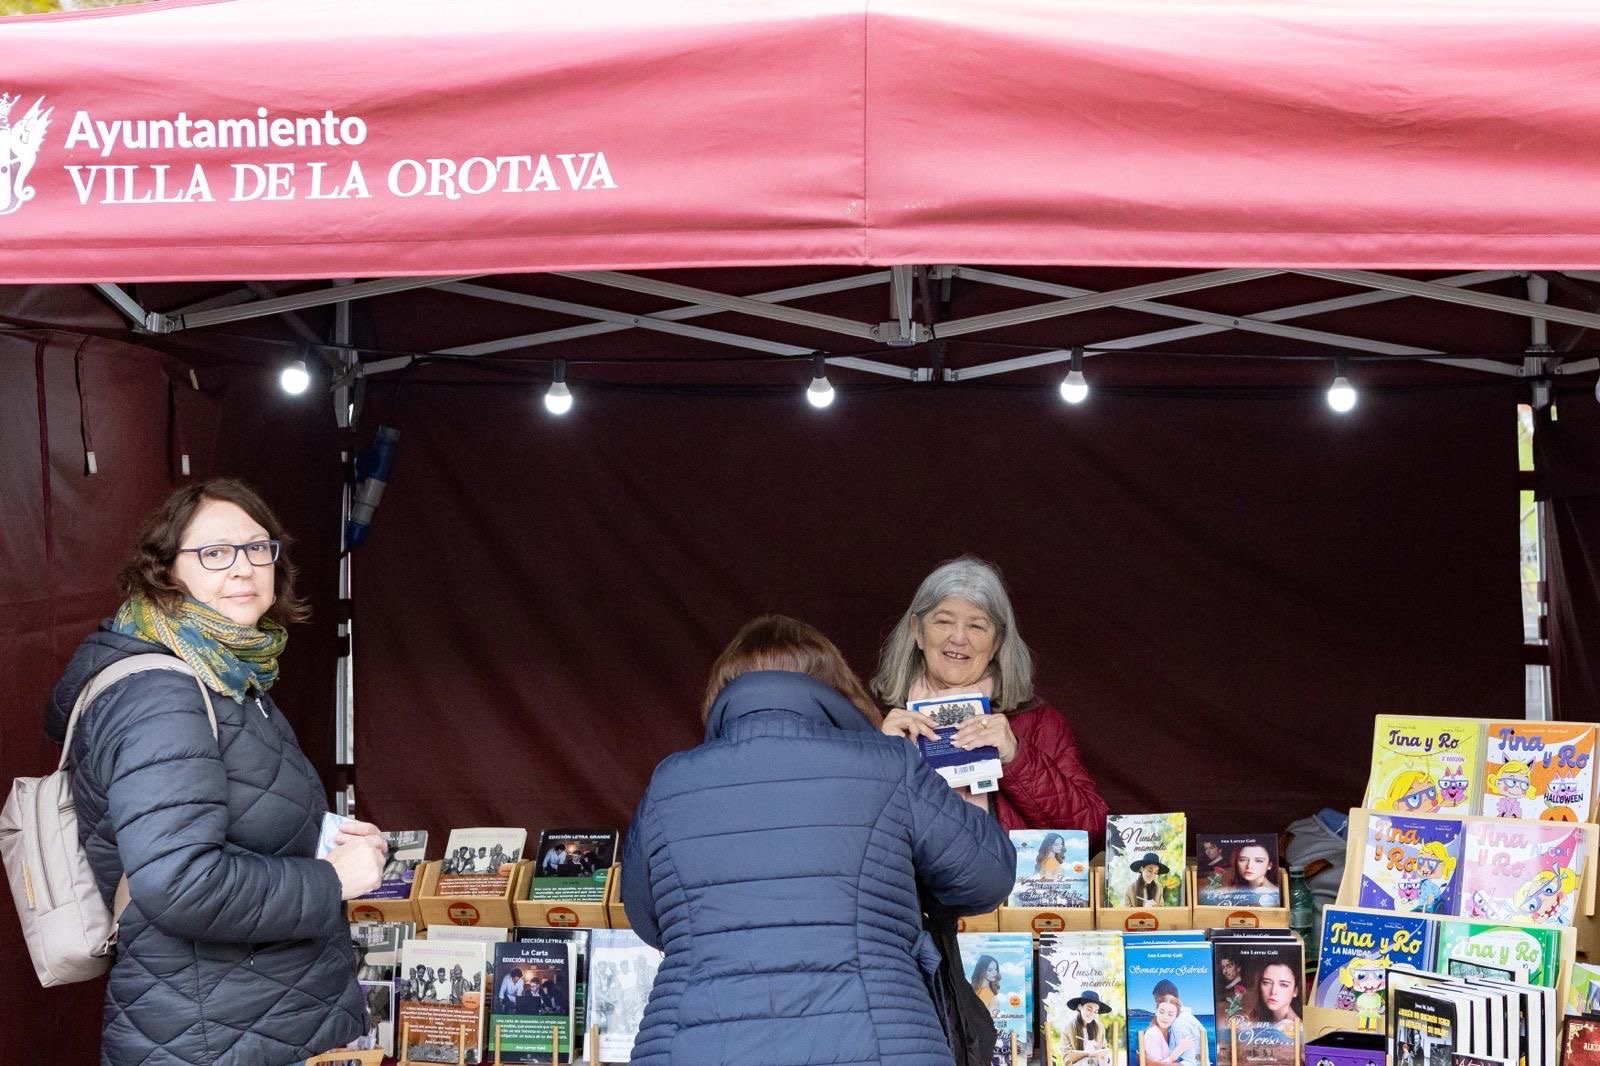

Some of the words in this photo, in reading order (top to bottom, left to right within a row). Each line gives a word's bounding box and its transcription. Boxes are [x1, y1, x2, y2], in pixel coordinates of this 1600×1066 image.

[64, 107, 368, 156] Ayuntamiento
[65, 163, 216, 205] VILLA
[230, 162, 296, 202] DE
[304, 160, 373, 201] LA
[386, 151, 619, 200] OROTAVA
[1388, 729, 1422, 747] Tina
[1424, 737, 1433, 752] y
[1438, 732, 1460, 749] Ro
[1498, 727, 1545, 752] Tina
[1542, 751, 1552, 769] y
[1557, 744, 1590, 769] Ro
[1543, 792, 1584, 804] HALLOWEEN
[1120, 827, 1161, 845] Nuestro
[1133, 842, 1167, 852] momento
[1387, 847, 1417, 873] Ro
[1330, 922, 1375, 948] Tina
[1380, 937, 1389, 954] y
[1392, 929, 1422, 954] Ro
[1332, 946, 1341, 954] LA
[1342, 948, 1372, 957] NAVIDAD
[1499, 946, 1510, 966] y
[1515, 941, 1539, 962] Ro
[1055, 960, 1104, 979] Nuestro
[1128, 964, 1158, 975] Sonata
[1158, 966, 1175, 976] para
[1175, 964, 1209, 976] Gabriela
[1080, 977, 1121, 988] momento
[1256, 1020, 1271, 1028] un
